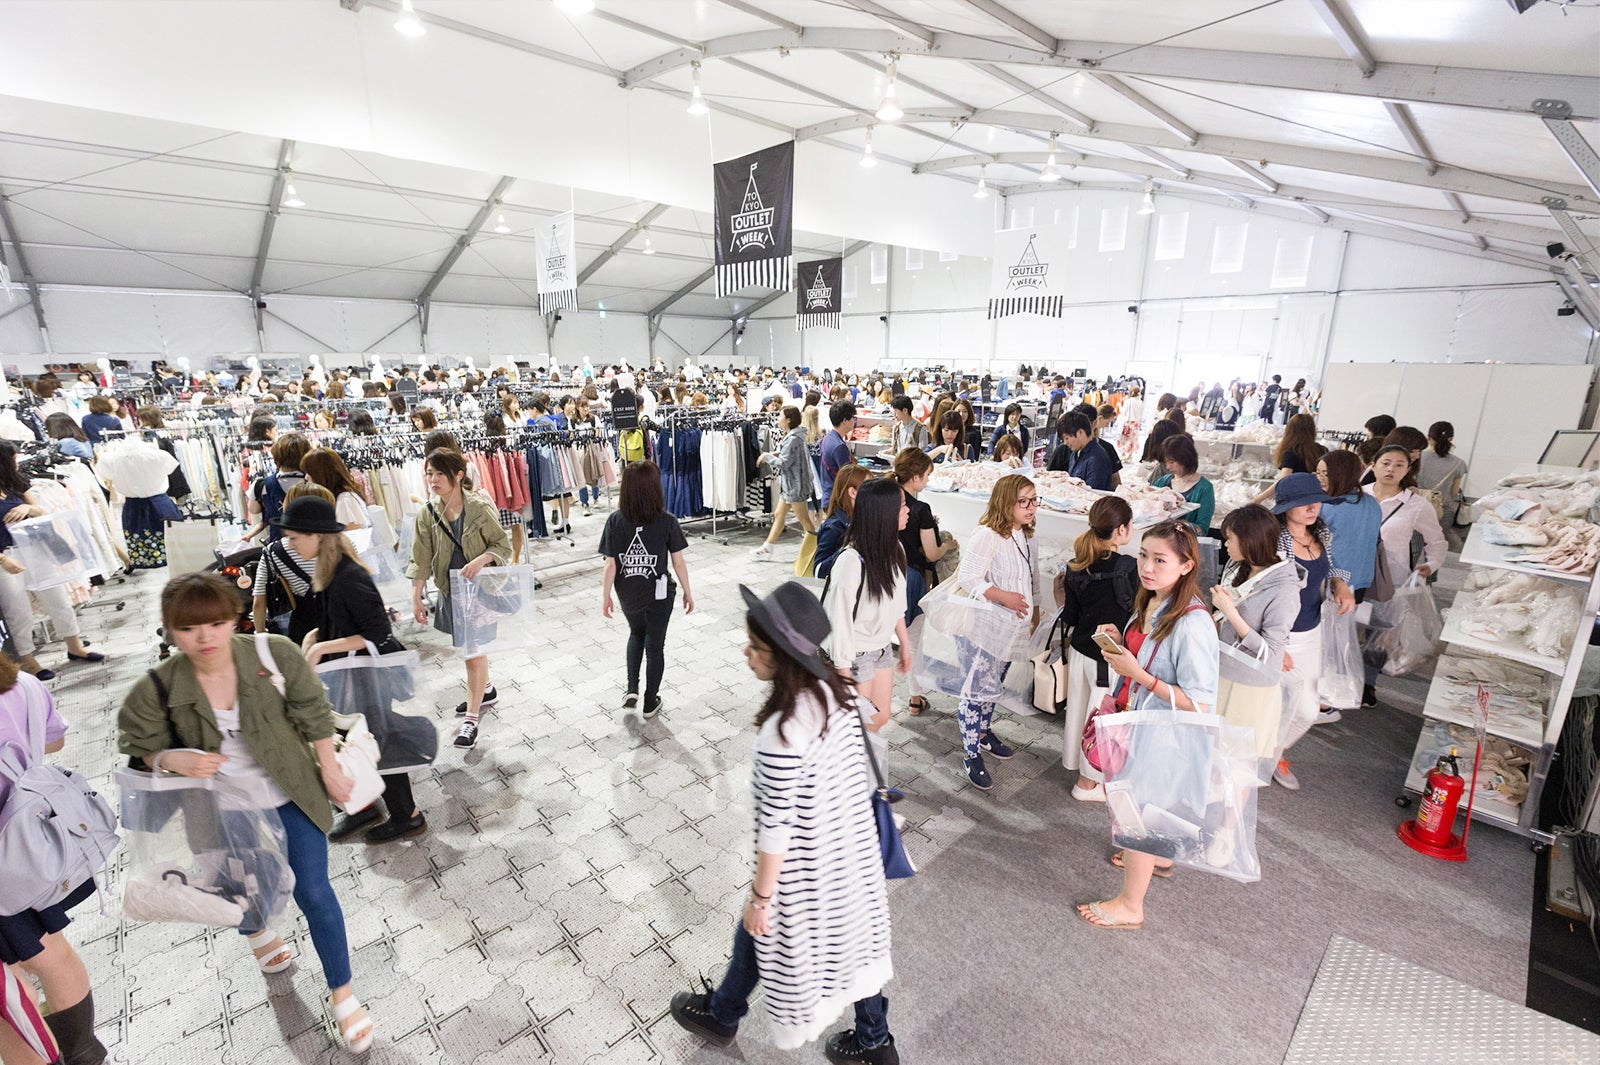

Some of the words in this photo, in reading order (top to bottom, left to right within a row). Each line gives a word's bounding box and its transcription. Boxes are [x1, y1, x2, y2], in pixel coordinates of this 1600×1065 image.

[747, 191, 757, 201] TO
[744, 201, 760, 212] KYO
[735, 212, 770, 229] OUTLET
[548, 257, 565, 268] OUTLET
[1012, 266, 1044, 275] OUTLET
[622, 556, 654, 566] OUTLET
